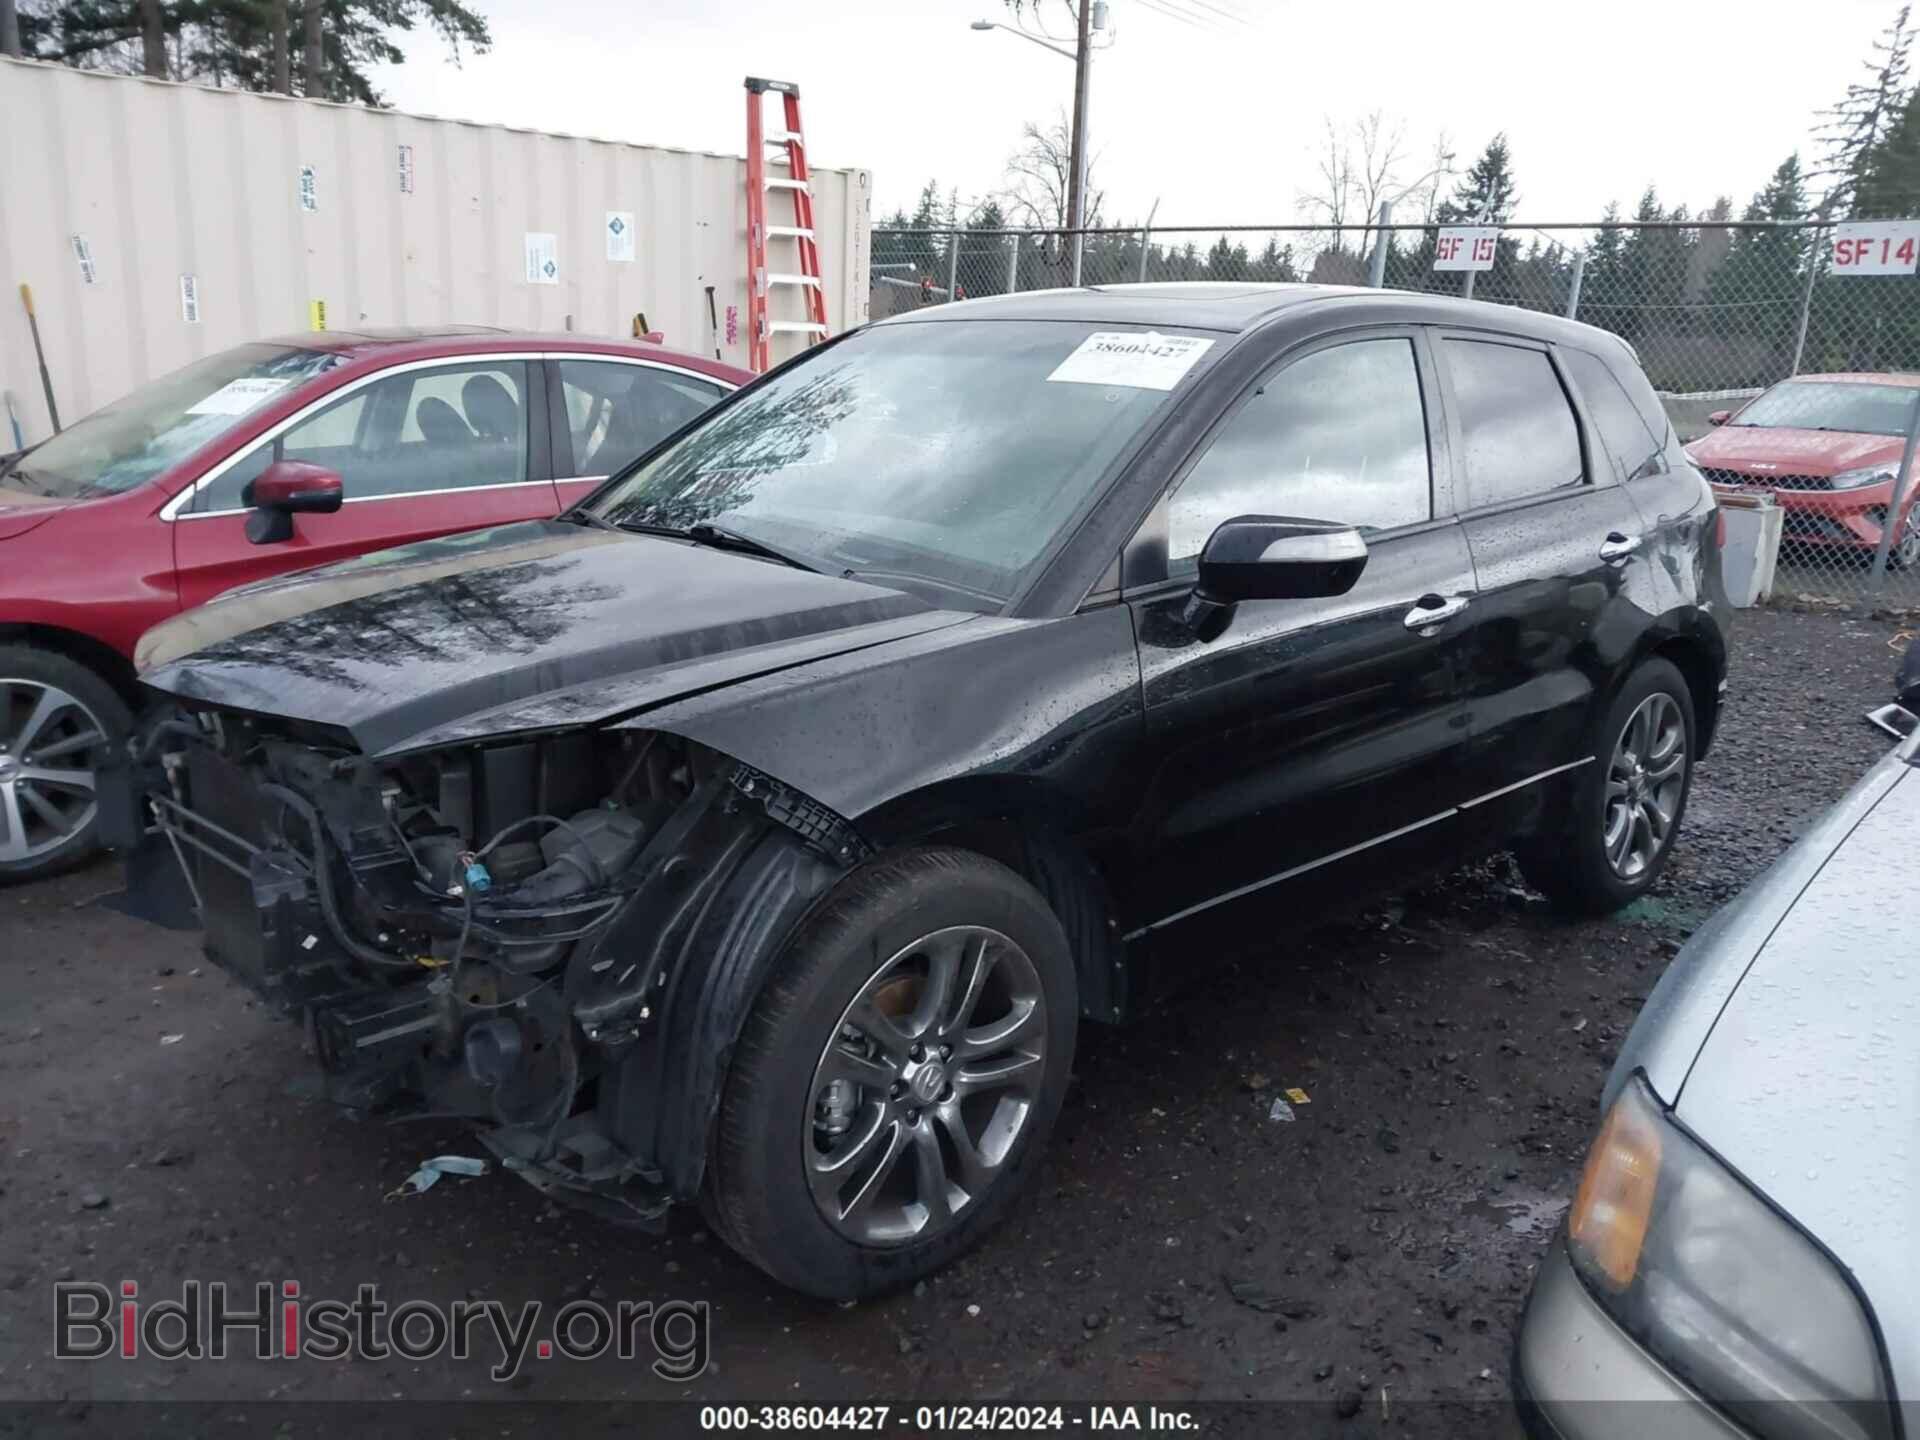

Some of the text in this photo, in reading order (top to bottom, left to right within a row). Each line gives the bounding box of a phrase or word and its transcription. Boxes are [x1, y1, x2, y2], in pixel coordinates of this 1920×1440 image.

[1472, 238, 1494, 261] 15
[1836, 238, 1914, 265] SF 14
